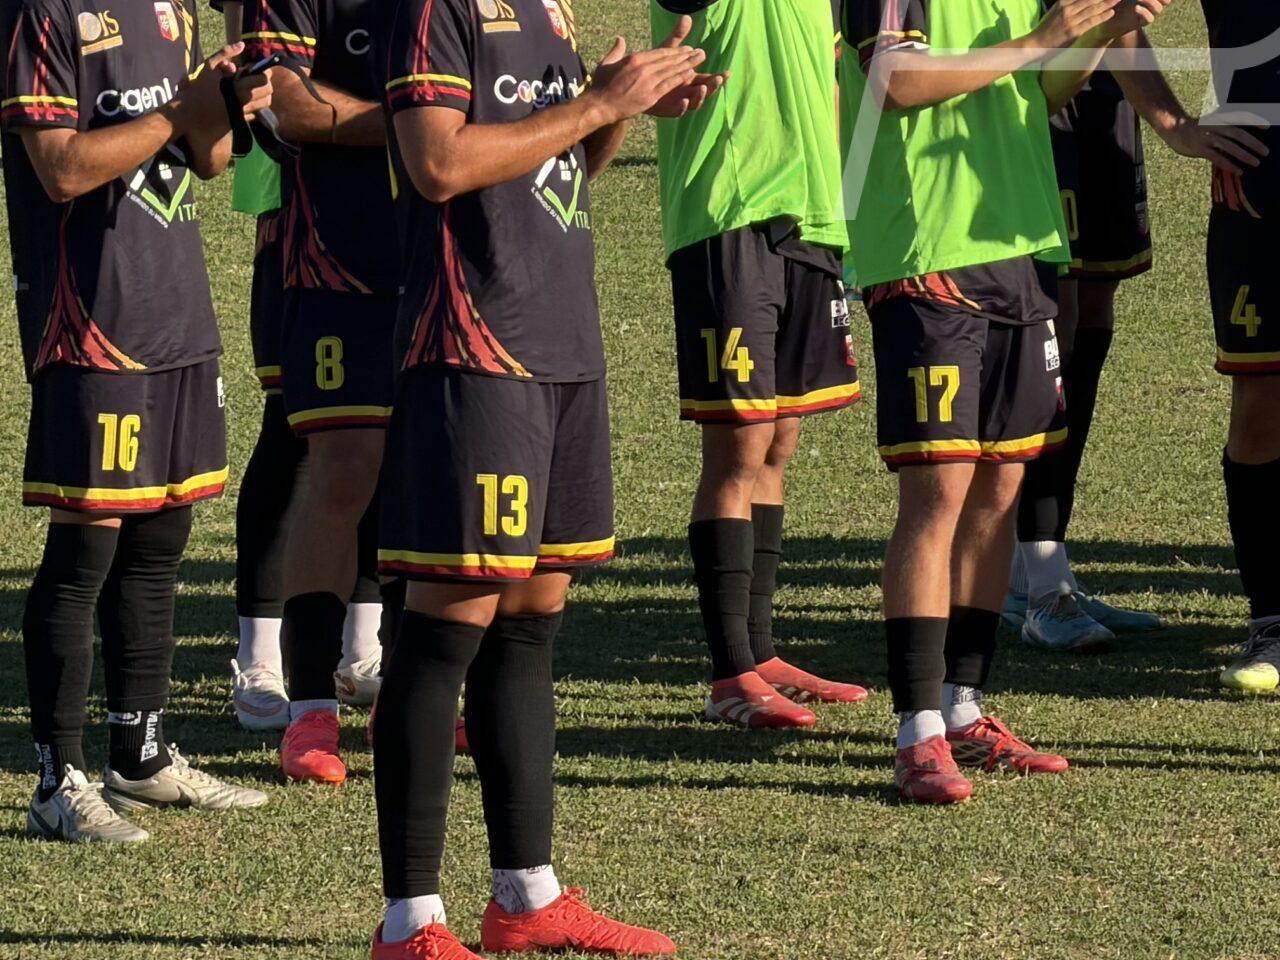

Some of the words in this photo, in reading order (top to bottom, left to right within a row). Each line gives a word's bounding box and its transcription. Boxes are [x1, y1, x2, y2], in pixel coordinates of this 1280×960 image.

[1230, 284, 1262, 338] 4
[315, 336, 345, 390] 8
[700, 327, 754, 383] 14
[907, 365, 961, 423] 17
[97, 413, 141, 472] 16
[476, 474, 529, 538] 13
